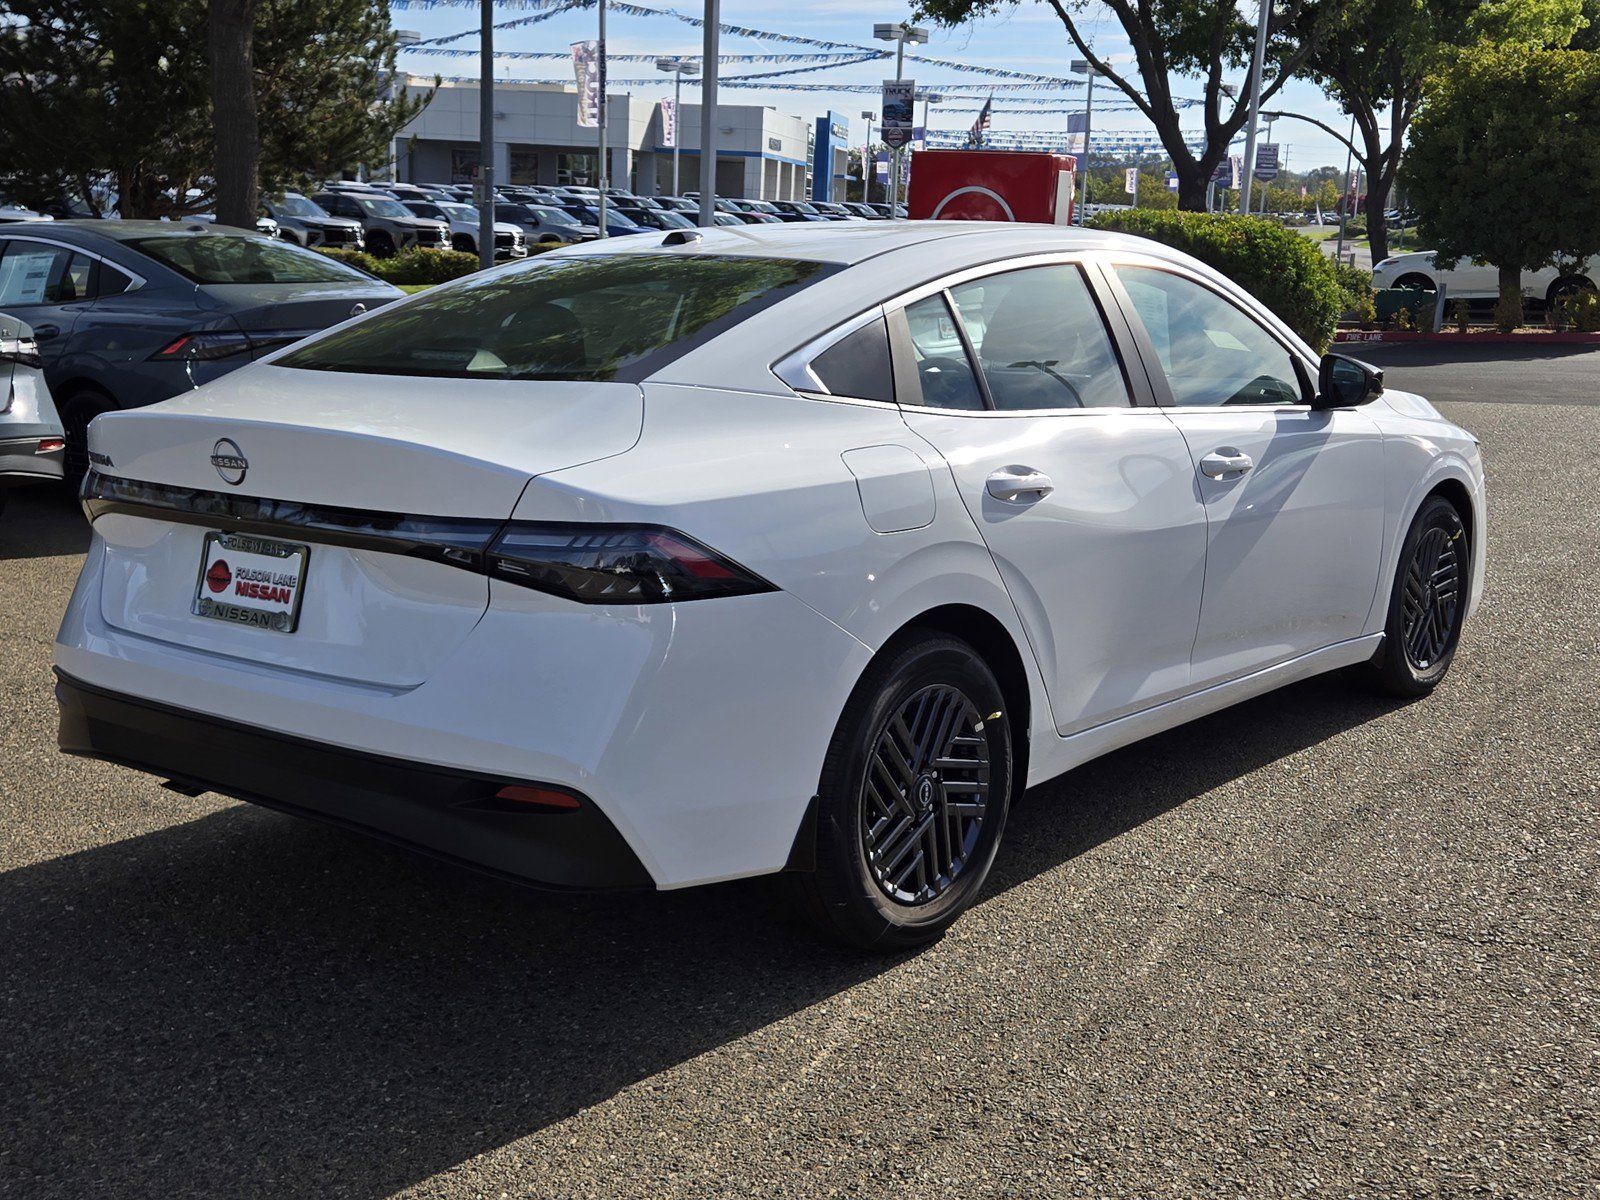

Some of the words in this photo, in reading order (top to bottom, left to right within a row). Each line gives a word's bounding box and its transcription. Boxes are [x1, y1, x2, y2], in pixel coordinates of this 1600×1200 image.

[1346, 333, 1361, 341] FIRE
[1363, 333, 1383, 341] LANE
[235, 566, 273, 583] FOLSOM
[272, 571, 297, 588] LAKE
[235, 581, 291, 604] NISSAN
[214, 605, 270, 626] NISSAN
